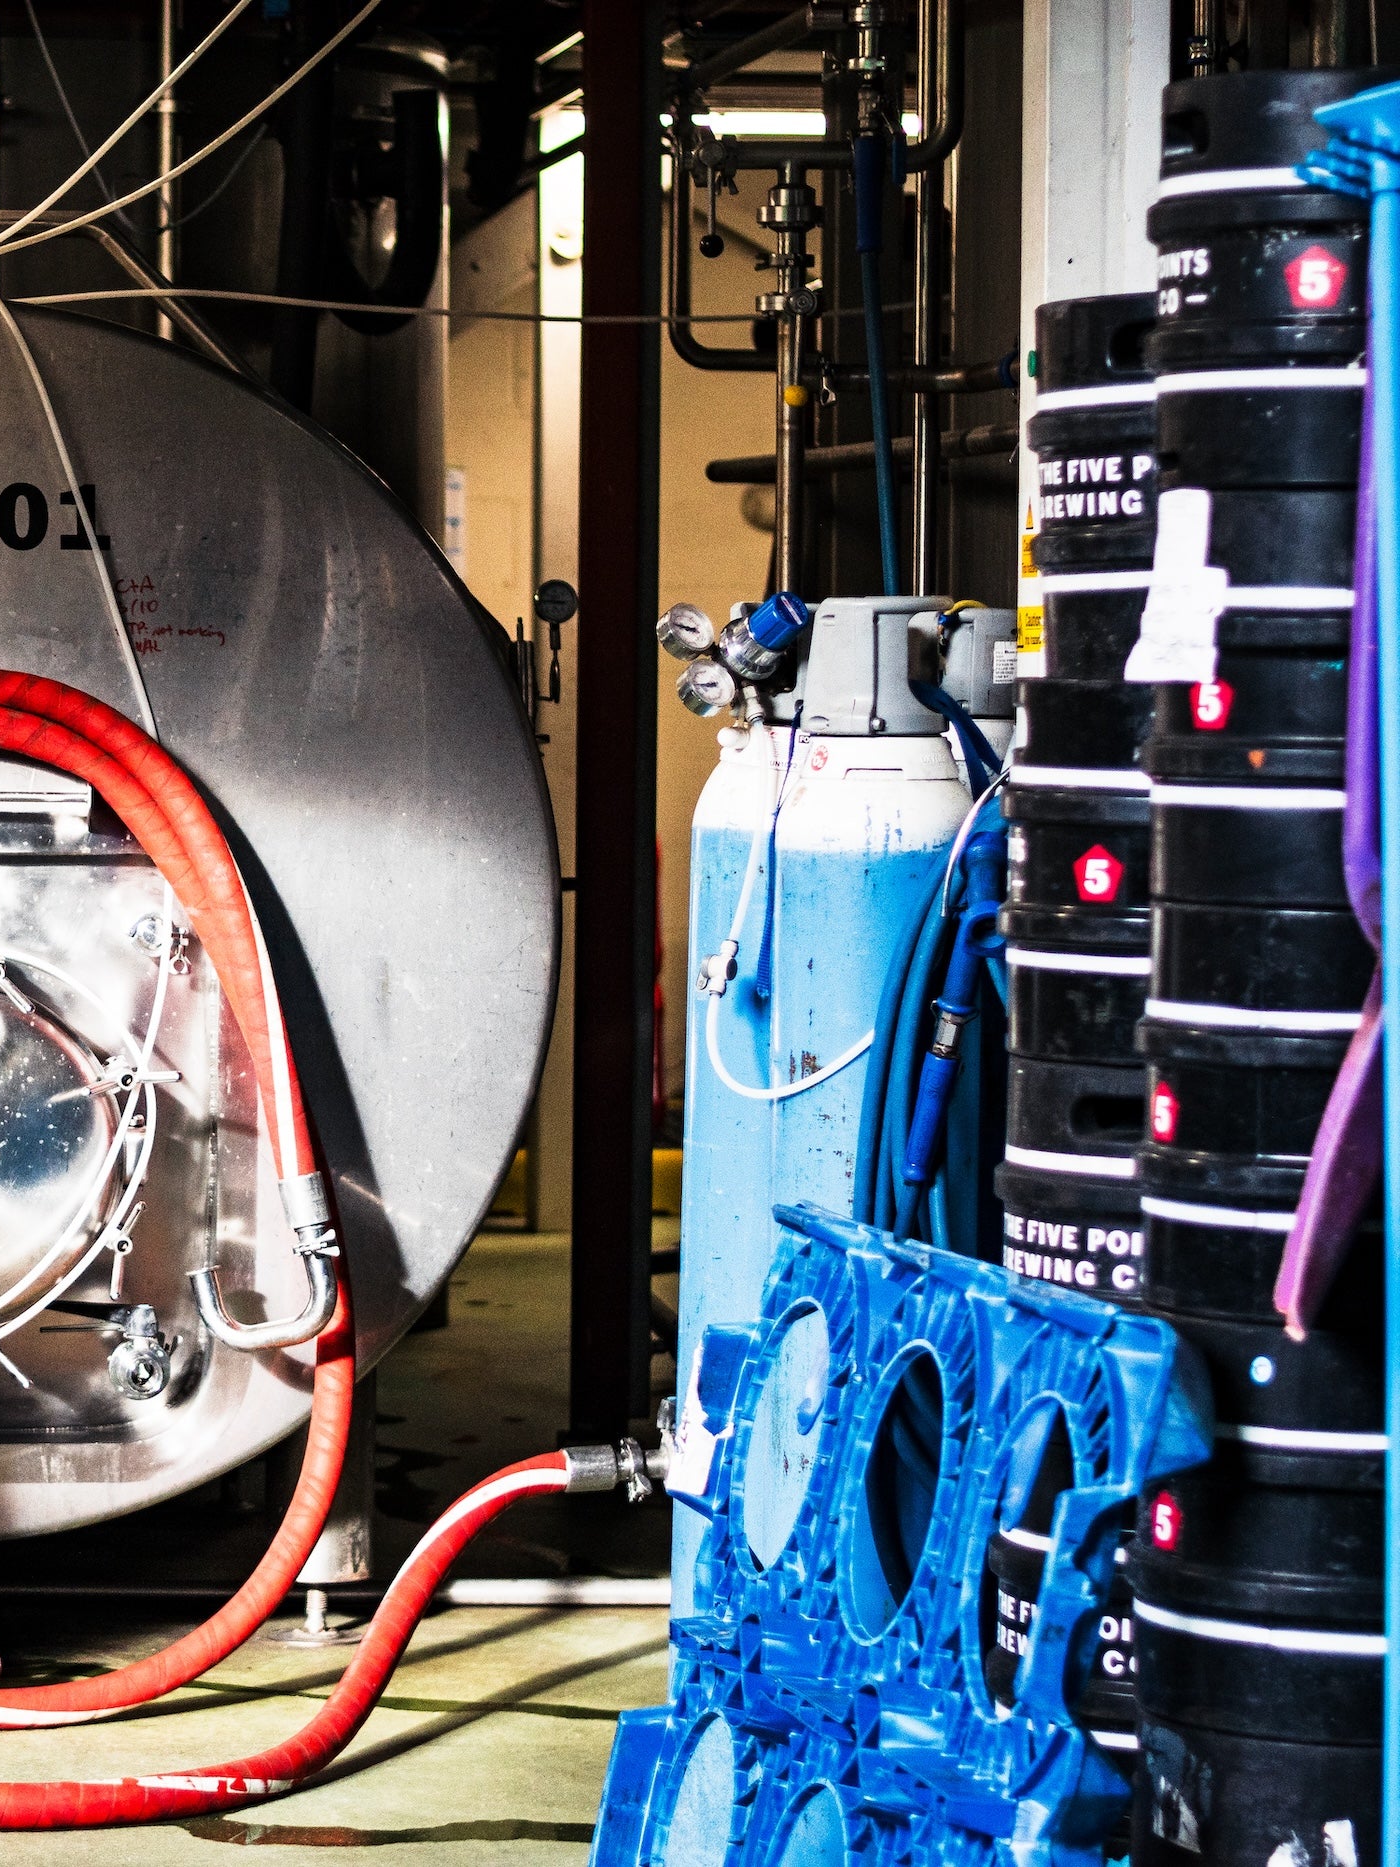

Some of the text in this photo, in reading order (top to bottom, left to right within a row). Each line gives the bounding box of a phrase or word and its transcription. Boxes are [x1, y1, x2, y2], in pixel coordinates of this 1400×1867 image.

[1298, 260, 1332, 301] 5
[1039, 460, 1062, 485] THE
[1067, 457, 1122, 484] FIVE
[1197, 683, 1222, 722] 5
[1084, 858, 1111, 895] 5
[1154, 1094, 1171, 1133] 5
[1027, 1219, 1079, 1250] FIVE
[1155, 1503, 1172, 1541] 5
